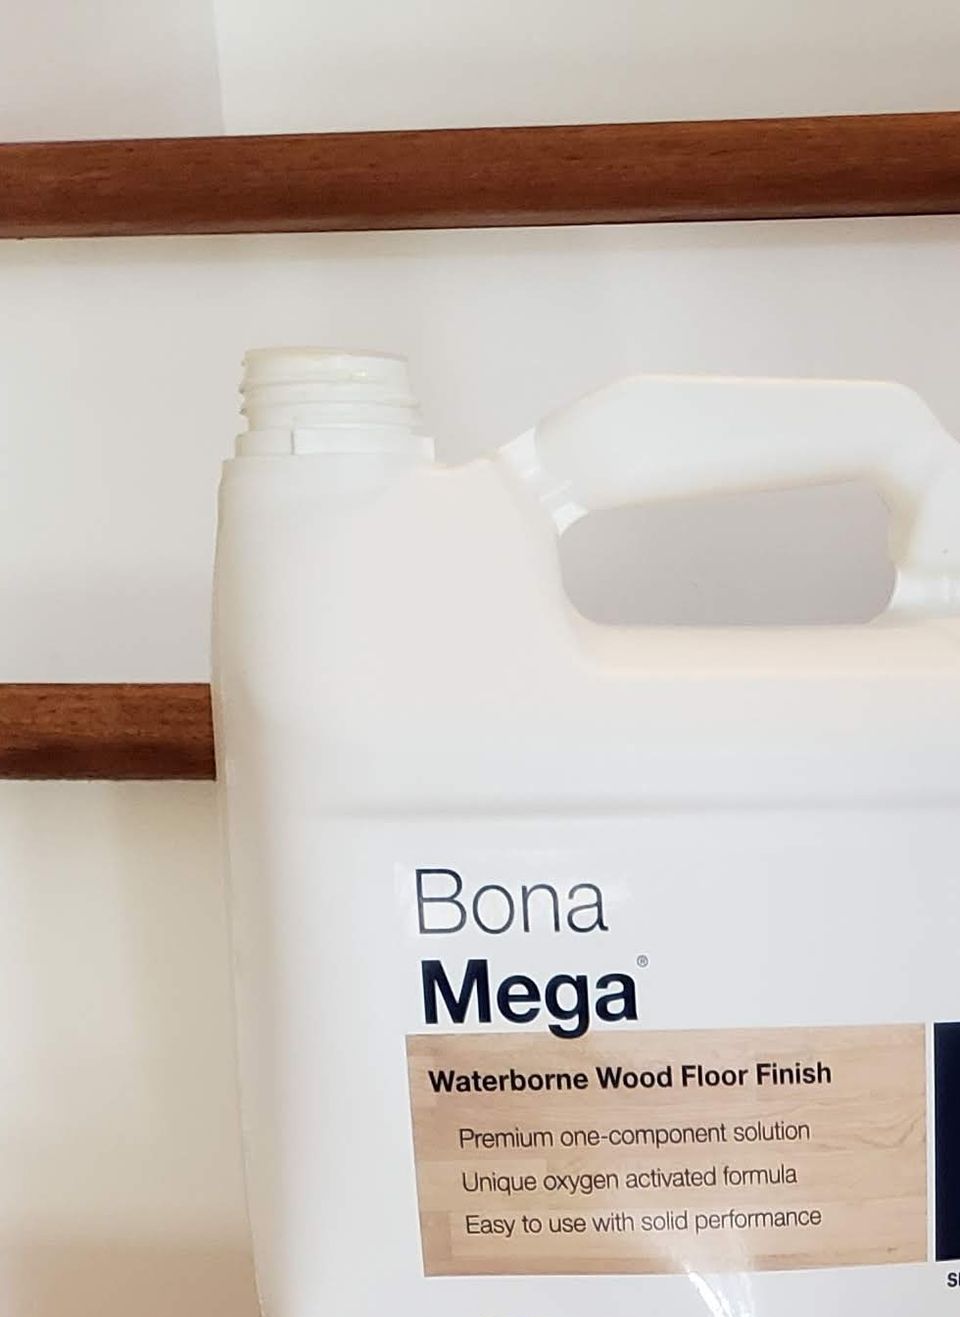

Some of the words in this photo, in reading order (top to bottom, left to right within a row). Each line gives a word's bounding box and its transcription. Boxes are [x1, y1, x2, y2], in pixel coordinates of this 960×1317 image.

[415, 868, 609, 935] Bona
[428, 1068, 589, 1093] Waterborne
[596, 1065, 673, 1089] Wood
[681, 1064, 749, 1088] Floor
[756, 1061, 832, 1086] Finish
[459, 1127, 554, 1149] Premium
[560, 1123, 728, 1149] one-component
[733, 1120, 811, 1143] solution
[462, 1171, 538, 1197] Unique
[542, 1173, 619, 1195] oxygen
[625, 1165, 717, 1189] activated
[722, 1162, 798, 1186] formula
[465, 1214, 516, 1238] Easy
[521, 1214, 543, 1234] to
[548, 1216, 587, 1234] use
[591, 1211, 635, 1233] with
[640, 1209, 689, 1232] solid
[694, 1208, 822, 1235] performance
